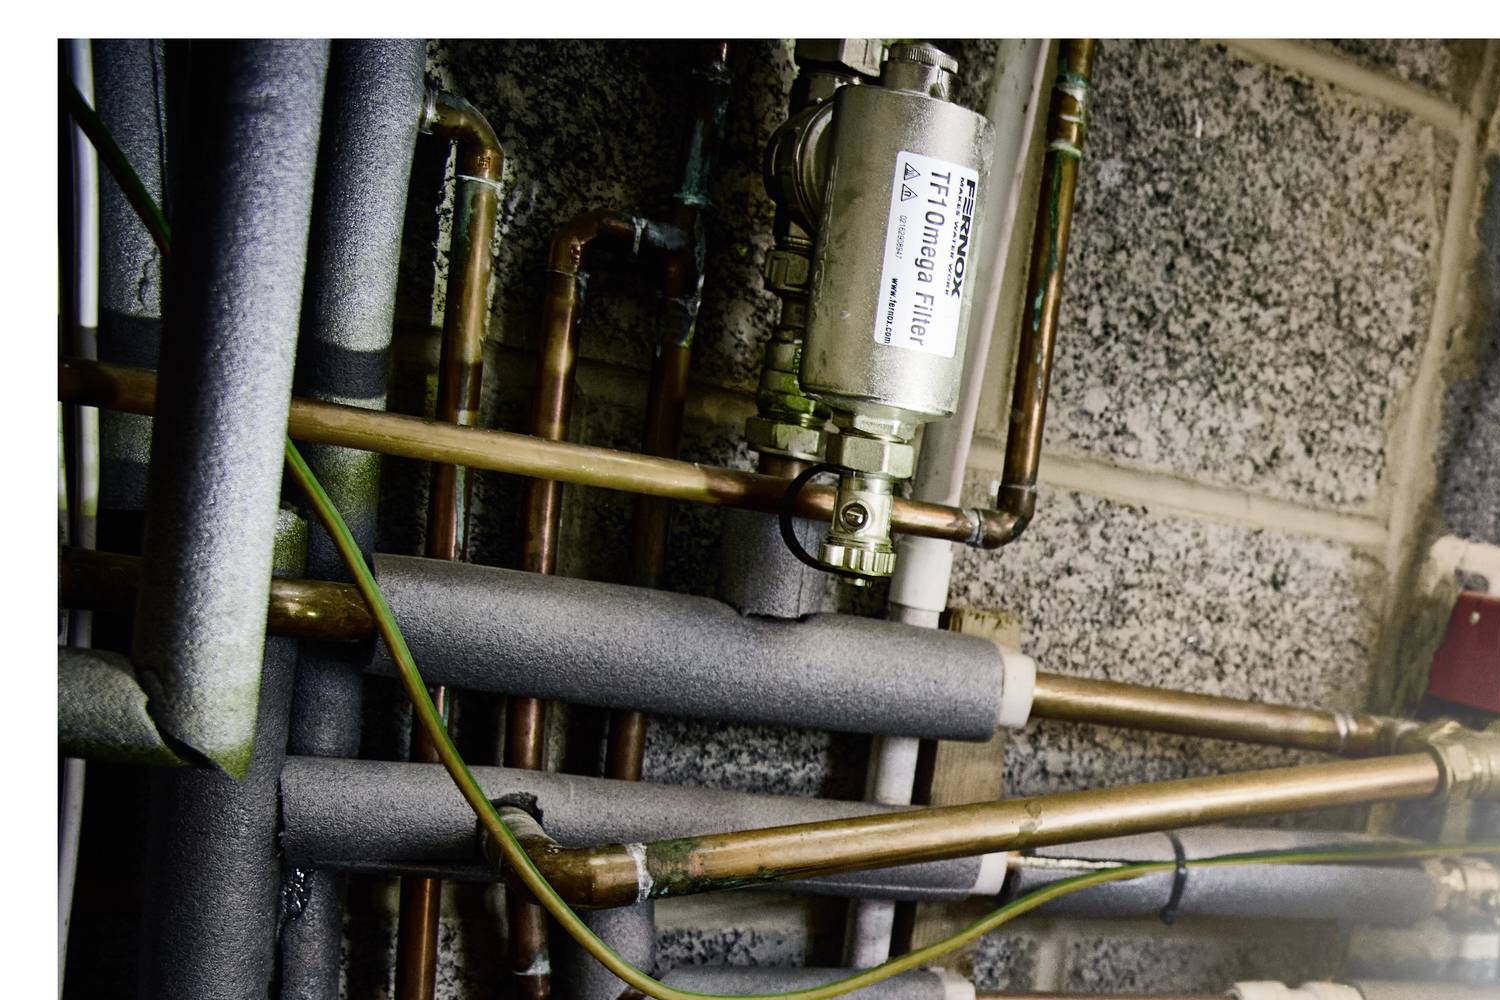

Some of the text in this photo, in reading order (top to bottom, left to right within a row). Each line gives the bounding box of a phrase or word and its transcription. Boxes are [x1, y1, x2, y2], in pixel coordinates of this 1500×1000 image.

[945, 177, 965, 295] MAKES WATER WORK
[951, 179, 976, 299] FERNOX
[884, 278, 898, 344] www.fernox.com
[909, 292, 935, 346] Filter
